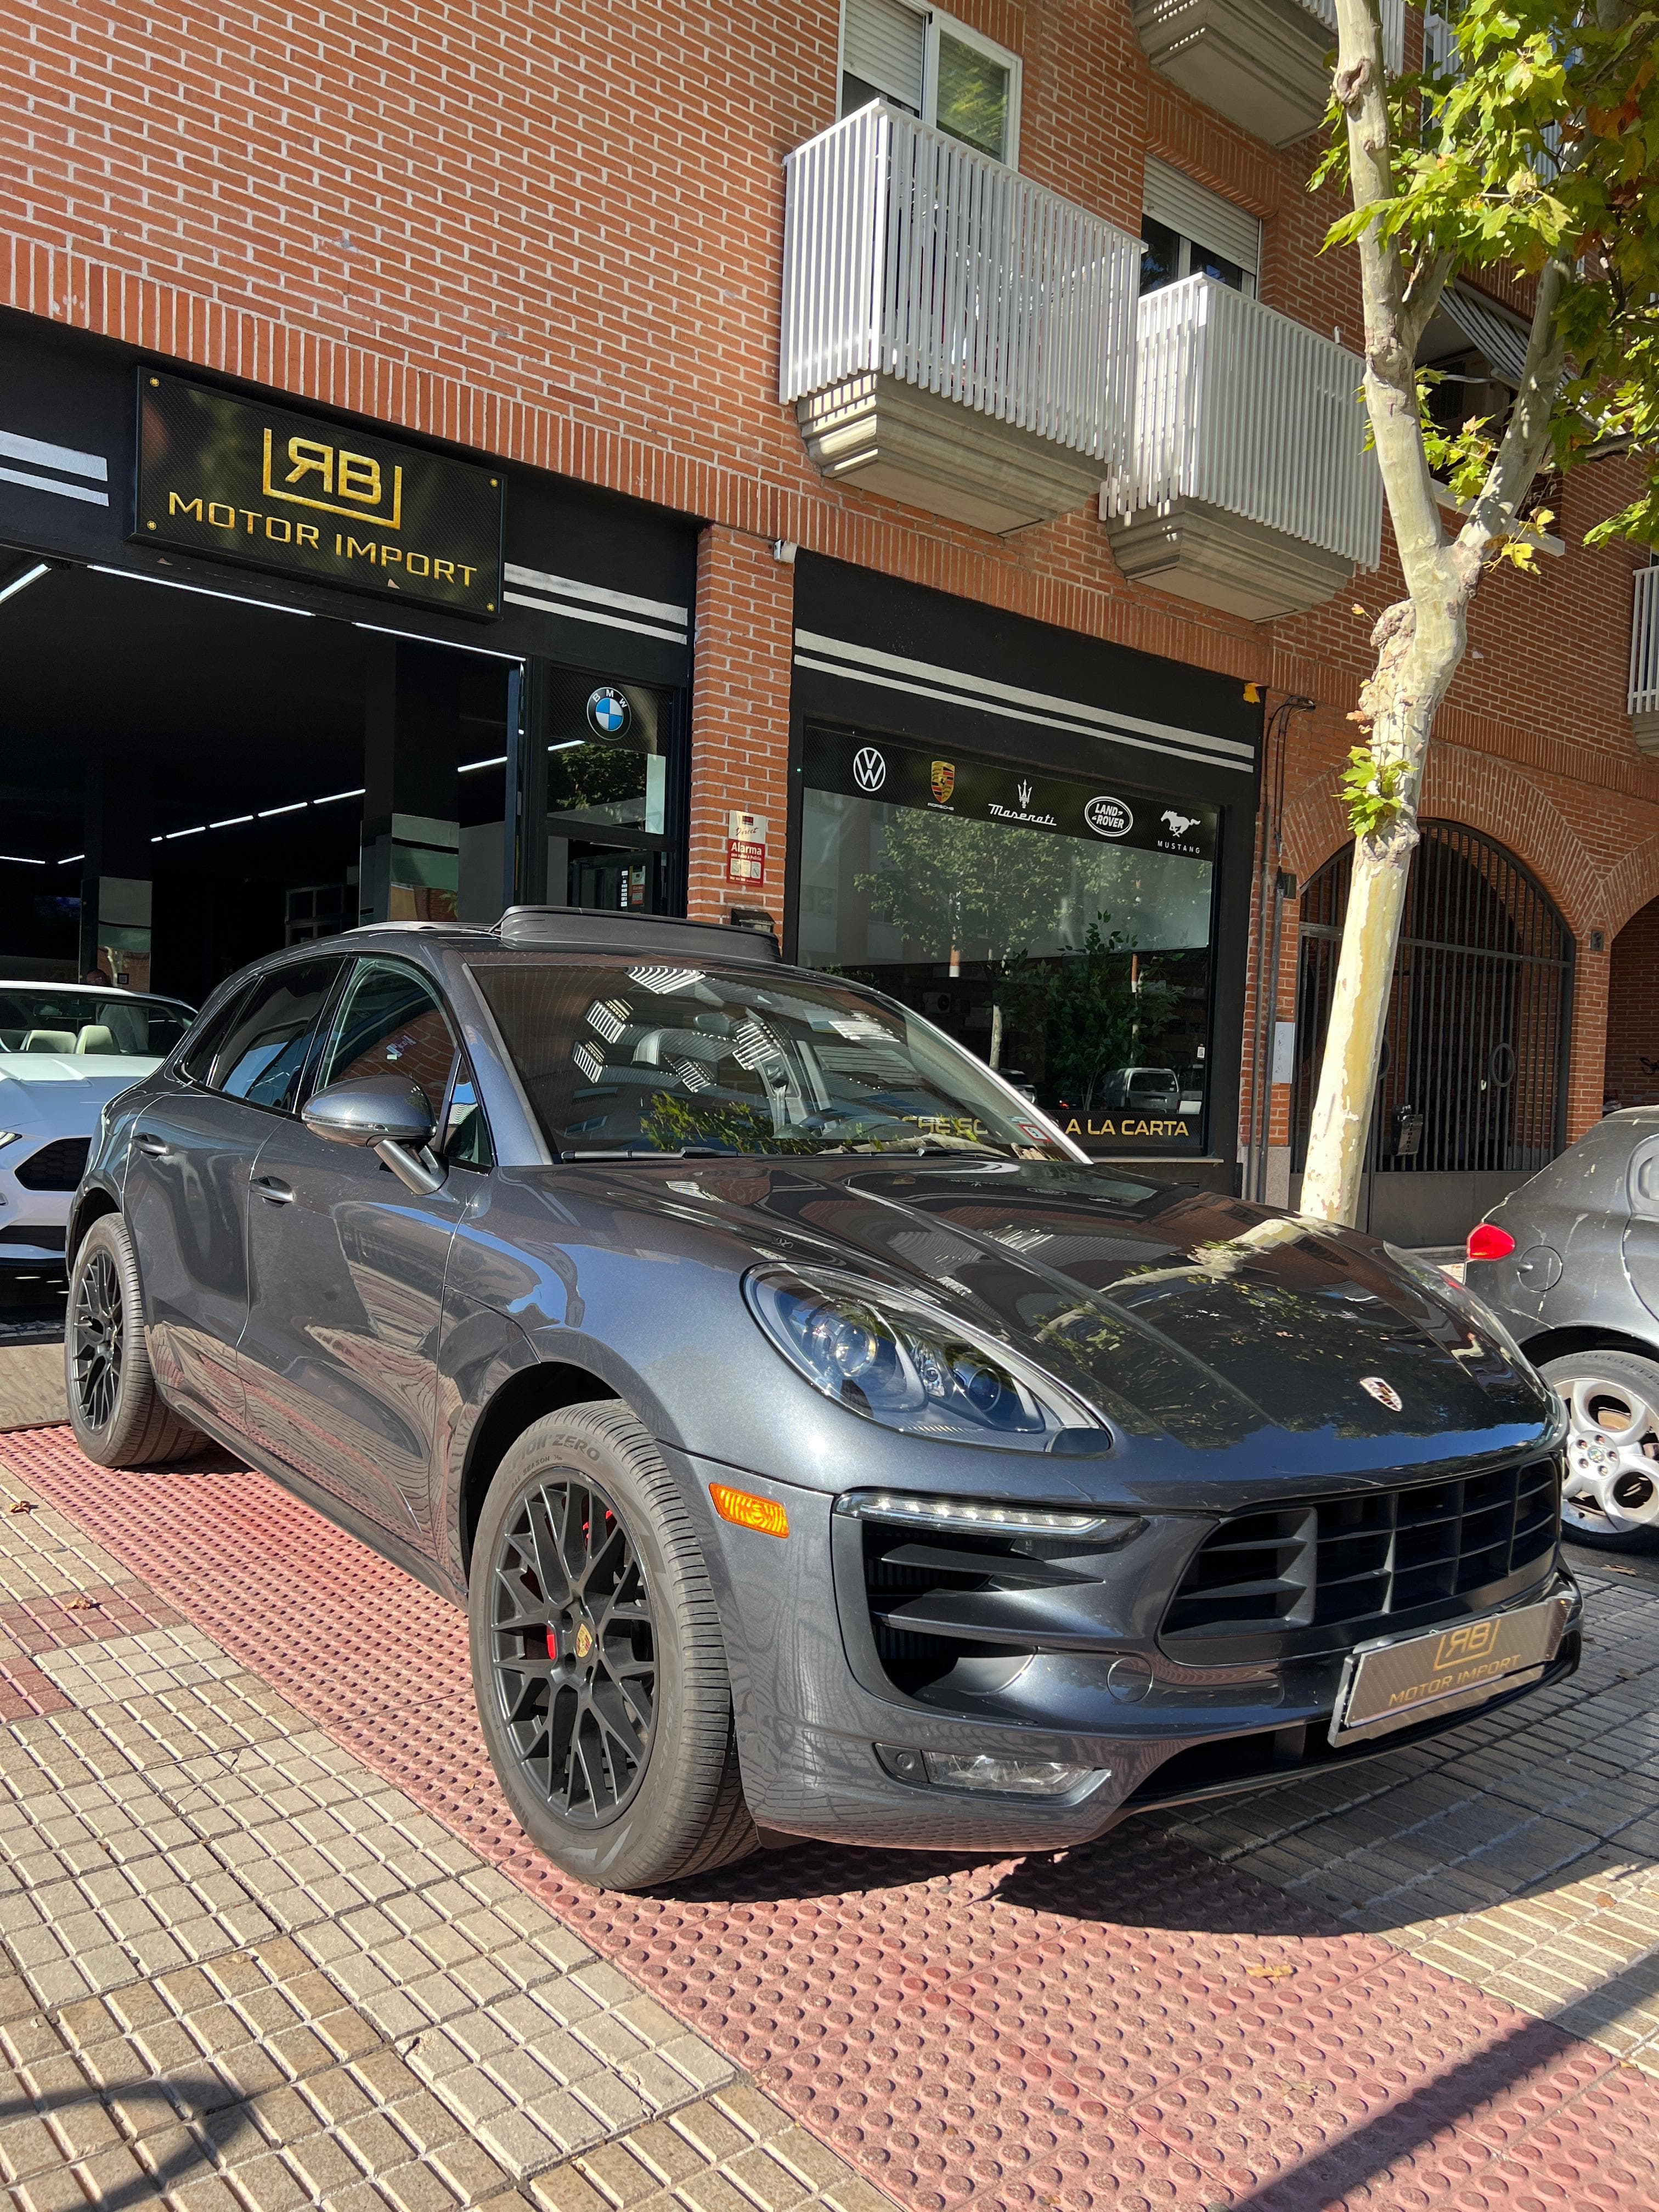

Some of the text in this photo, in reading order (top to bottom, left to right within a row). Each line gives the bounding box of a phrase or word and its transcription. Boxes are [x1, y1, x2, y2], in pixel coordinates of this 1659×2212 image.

[168, 491, 478, 588] MOTOR IMPORT
[592, 689, 628, 709] BMW
[988, 803, 1057, 826] Maserati
[1094, 803, 1119, 816] LAND
[1096, 815, 1125, 829] ROVER
[731, 842, 762, 856] Alarma
[1157, 840, 1201, 854] MUSTANG
[1065, 1119, 1082, 1135] A
[1087, 1119, 1116, 1135] LA
[1120, 1119, 1189, 1136] CARTA
[552, 1434, 600, 1462] ZERO
[523, 1455, 550, 1475] SEASON
[1388, 1654, 1521, 1707] MOTOR IMPORT
